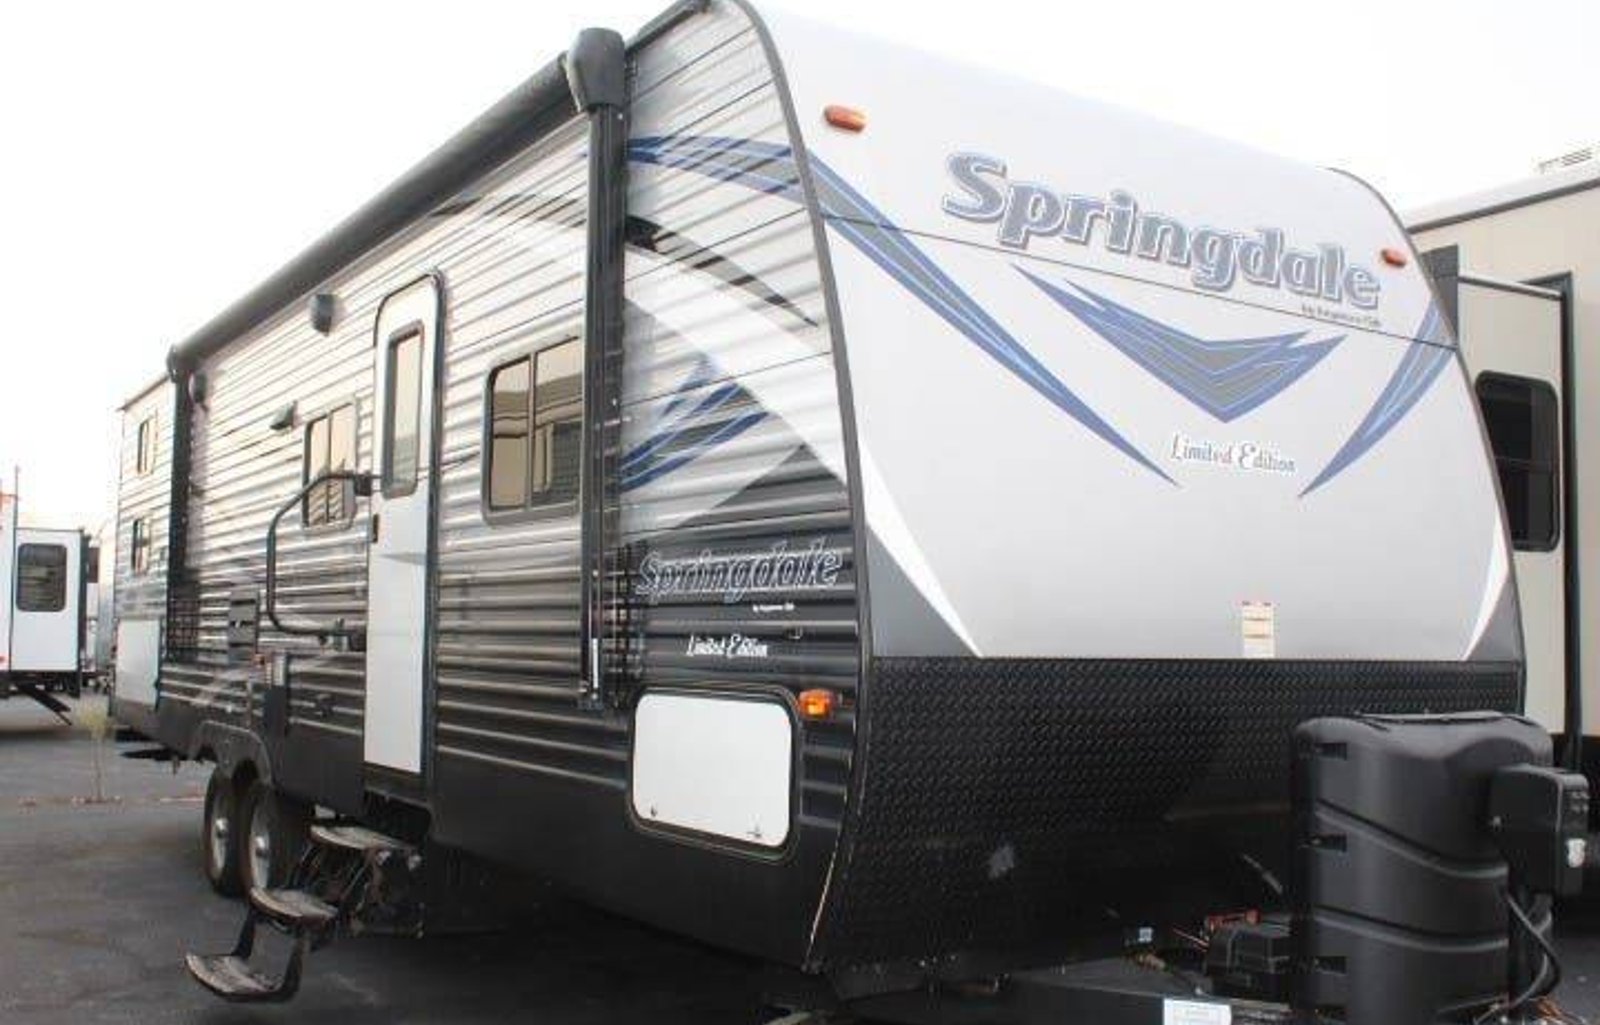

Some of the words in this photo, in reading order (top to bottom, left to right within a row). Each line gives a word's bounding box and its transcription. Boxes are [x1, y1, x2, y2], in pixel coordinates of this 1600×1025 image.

[942, 151, 1382, 309] Springdale
[1171, 433, 1232, 464] Limited
[1239, 442, 1296, 472] Edition
[635, 537, 842, 603] Springdale
